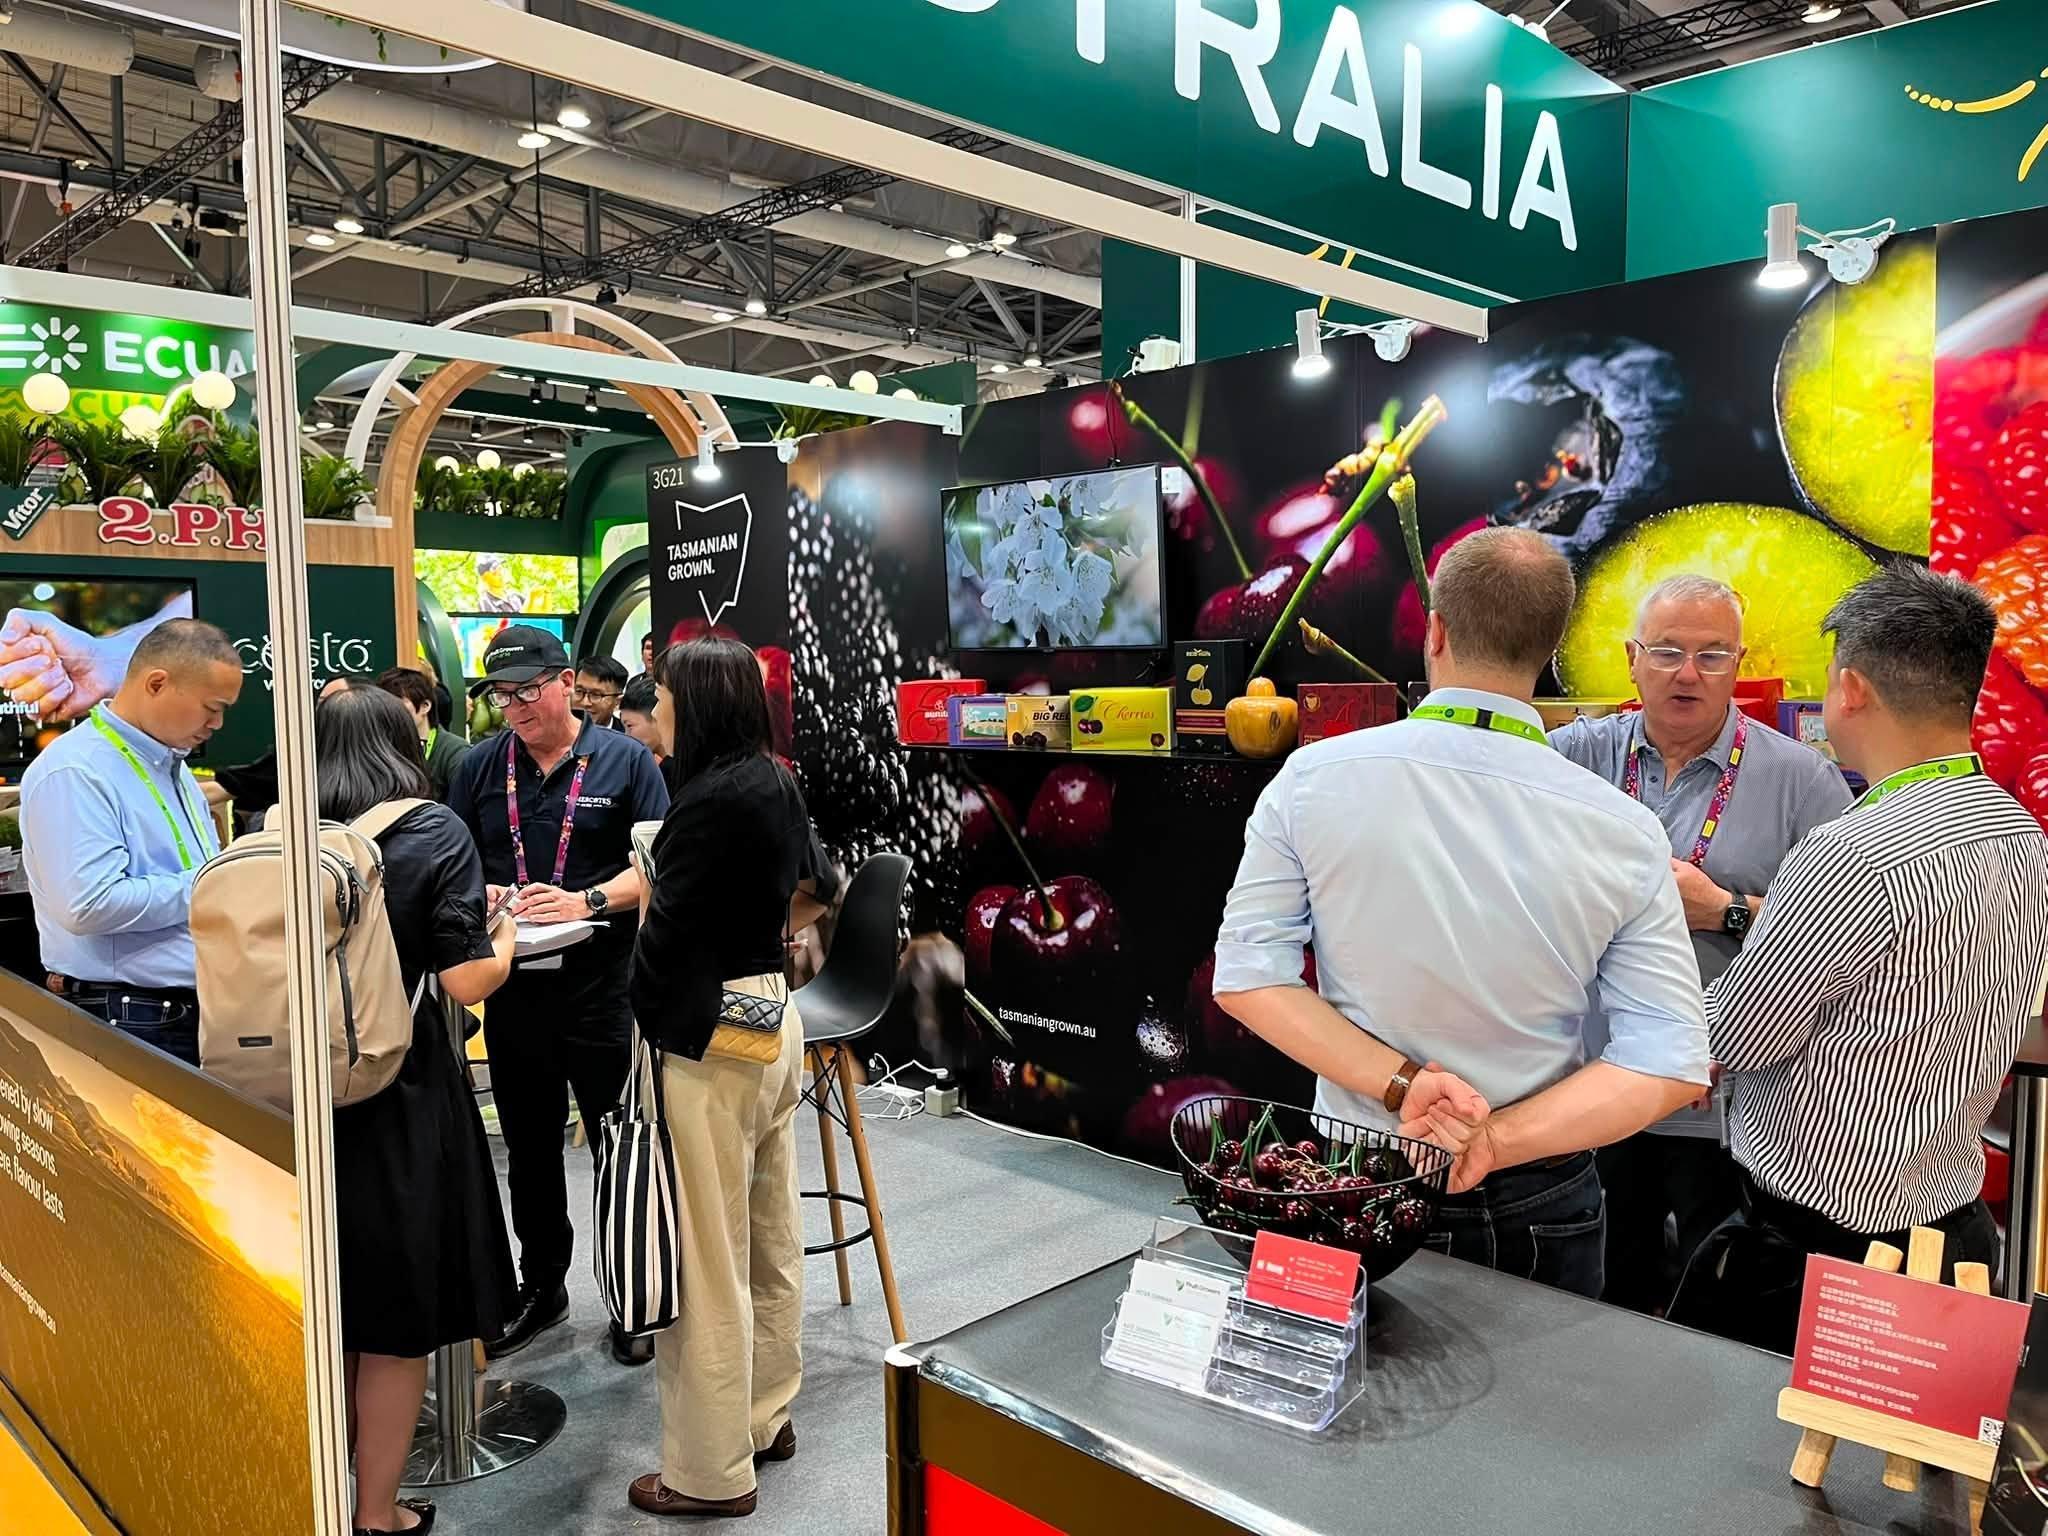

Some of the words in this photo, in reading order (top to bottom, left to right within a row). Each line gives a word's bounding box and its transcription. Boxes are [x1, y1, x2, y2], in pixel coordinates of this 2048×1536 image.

[104, 331, 257, 379] ECUA
[653, 467, 685, 490] 3G21
[2, 487, 45, 531] Vitor
[667, 532, 738, 561] TASMANIAN
[668, 558, 716, 581] GROWN.
[1033, 712, 1050, 721] BIG
[1100, 700, 1155, 721] Cherries
[999, 1007, 1096, 1038] tasmaniangrown.au
[20, 1085, 31, 1125] by
[33, 1097, 53, 1134] slow
[21, 1131, 58, 1177] seasons.
[13, 1154, 41, 1202] flavour
[42, 1178, 66, 1224] lasts.
